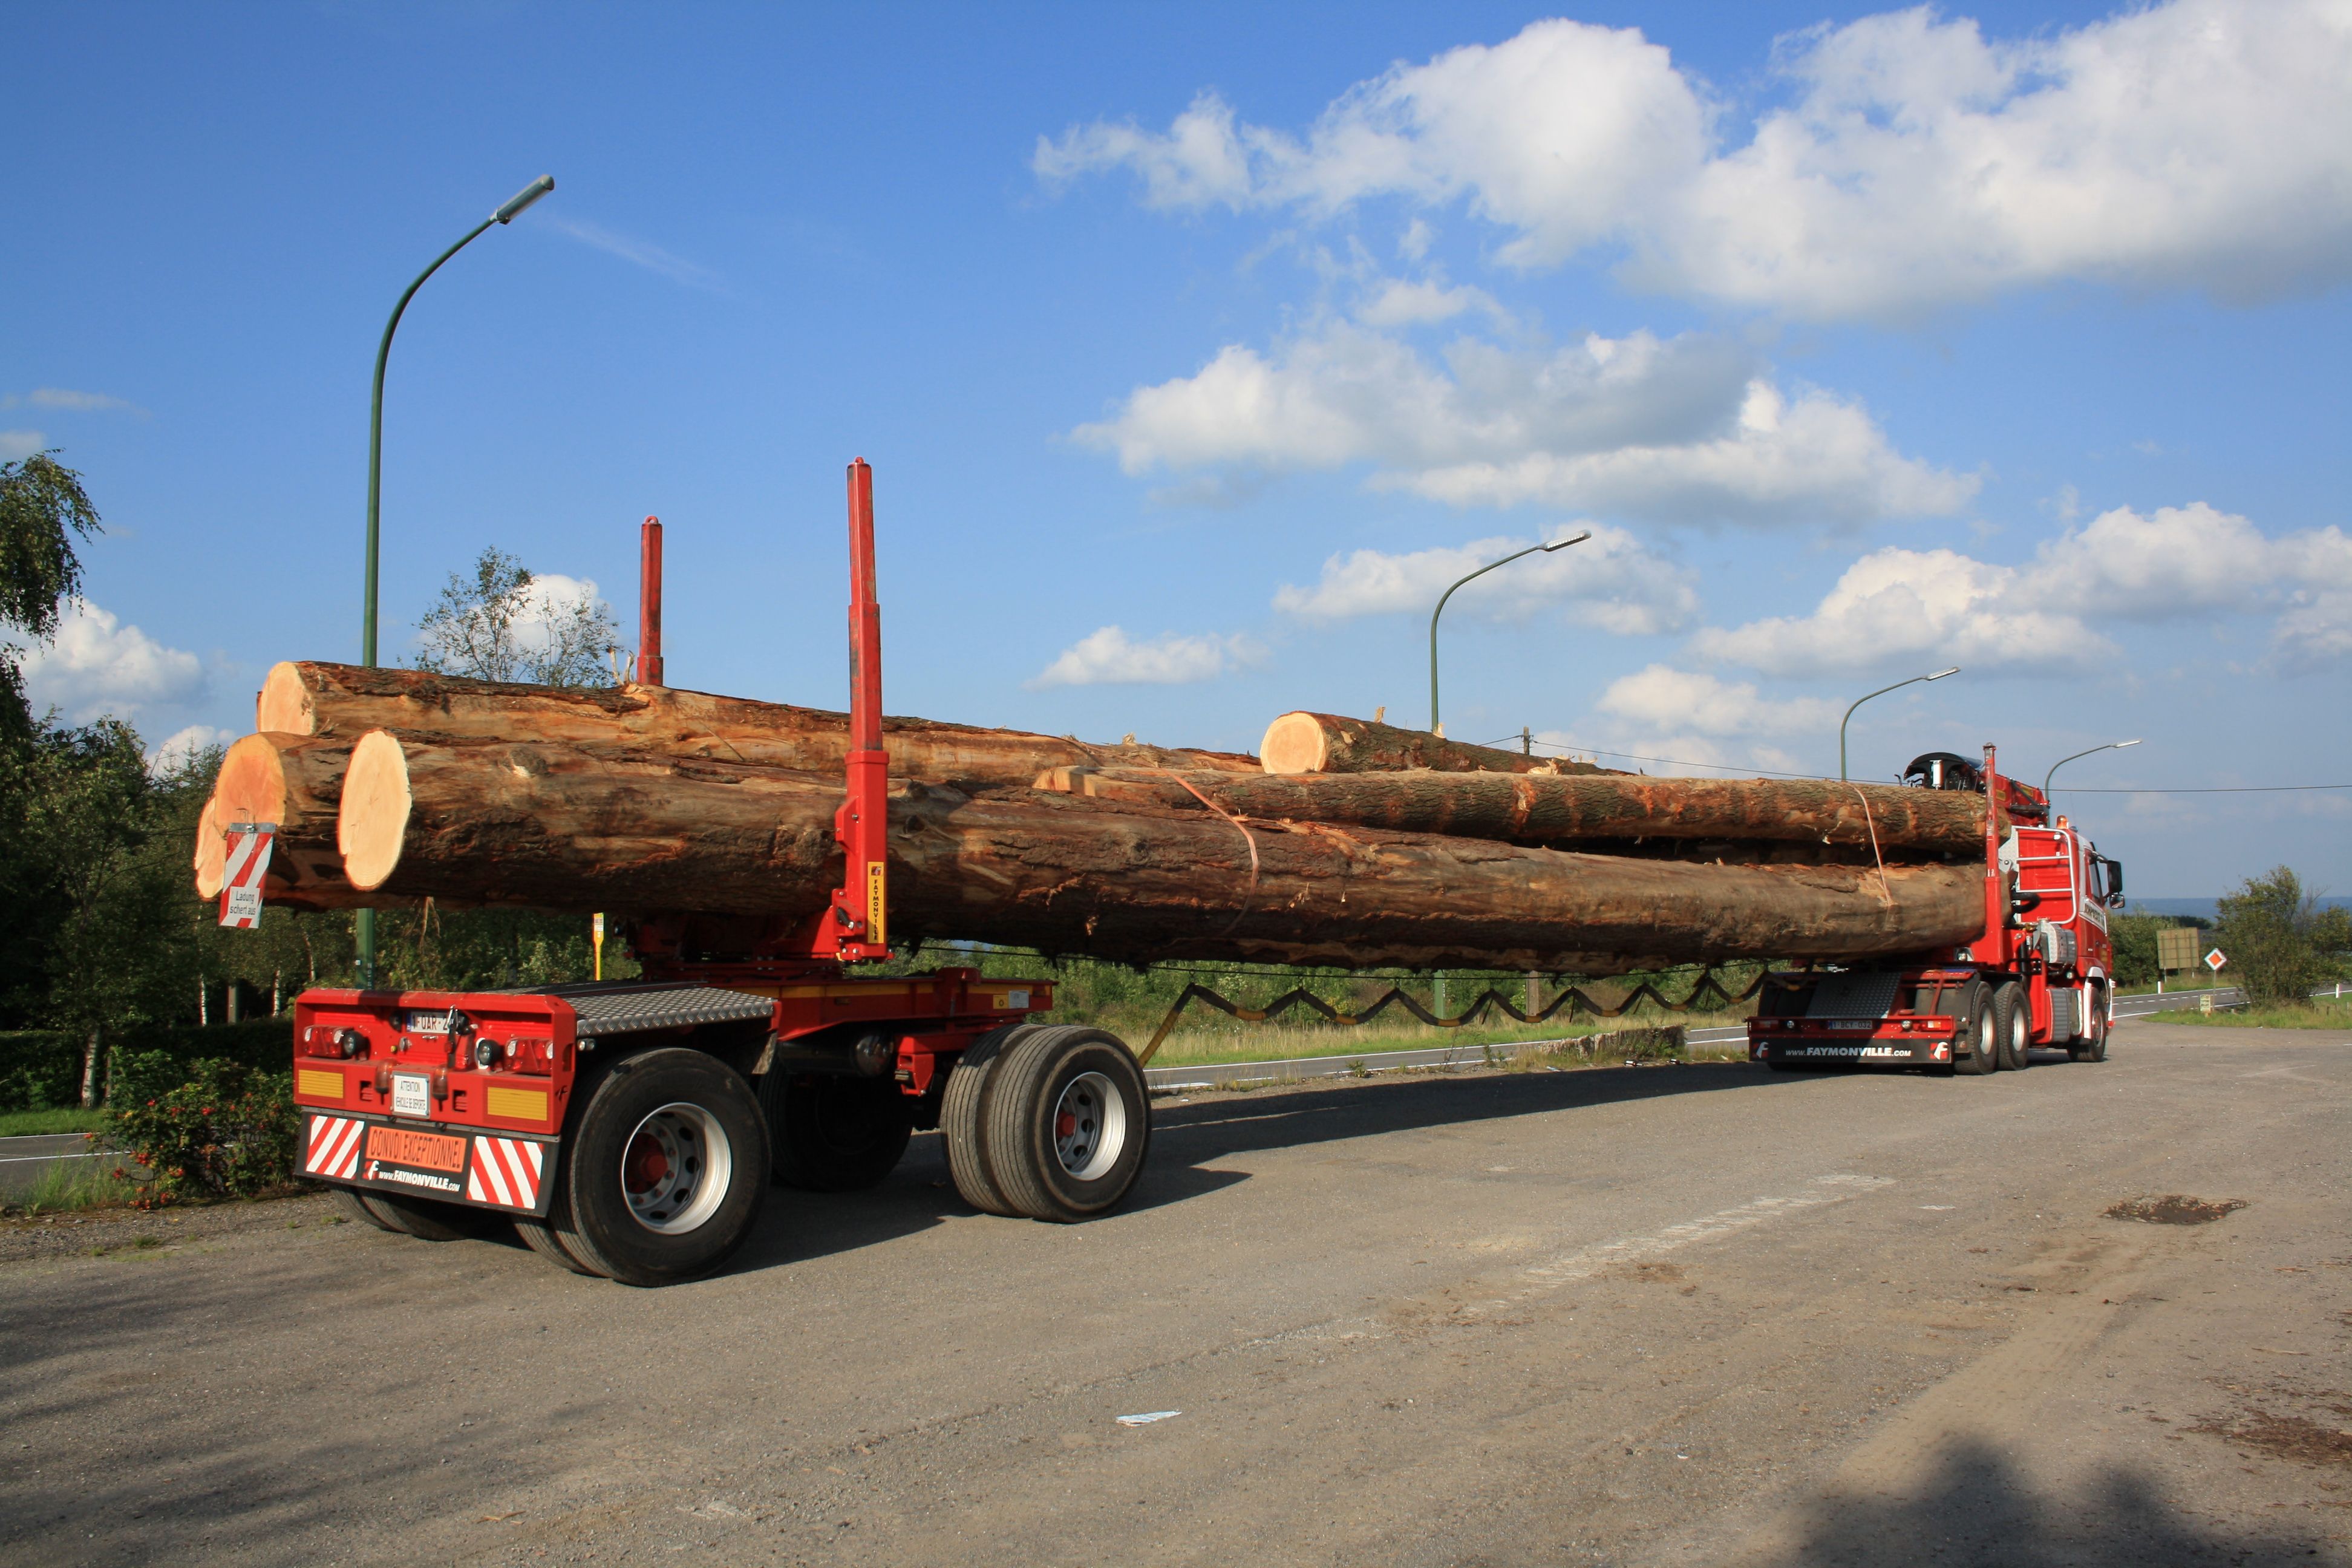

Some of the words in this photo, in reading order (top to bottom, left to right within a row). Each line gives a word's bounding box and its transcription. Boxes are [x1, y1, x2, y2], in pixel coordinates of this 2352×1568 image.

[236, 890, 255, 904] Ladung
[370, 1128, 402, 1160] CONVOI
[403, 1133, 462, 1169] EXCEPTIONNEL
